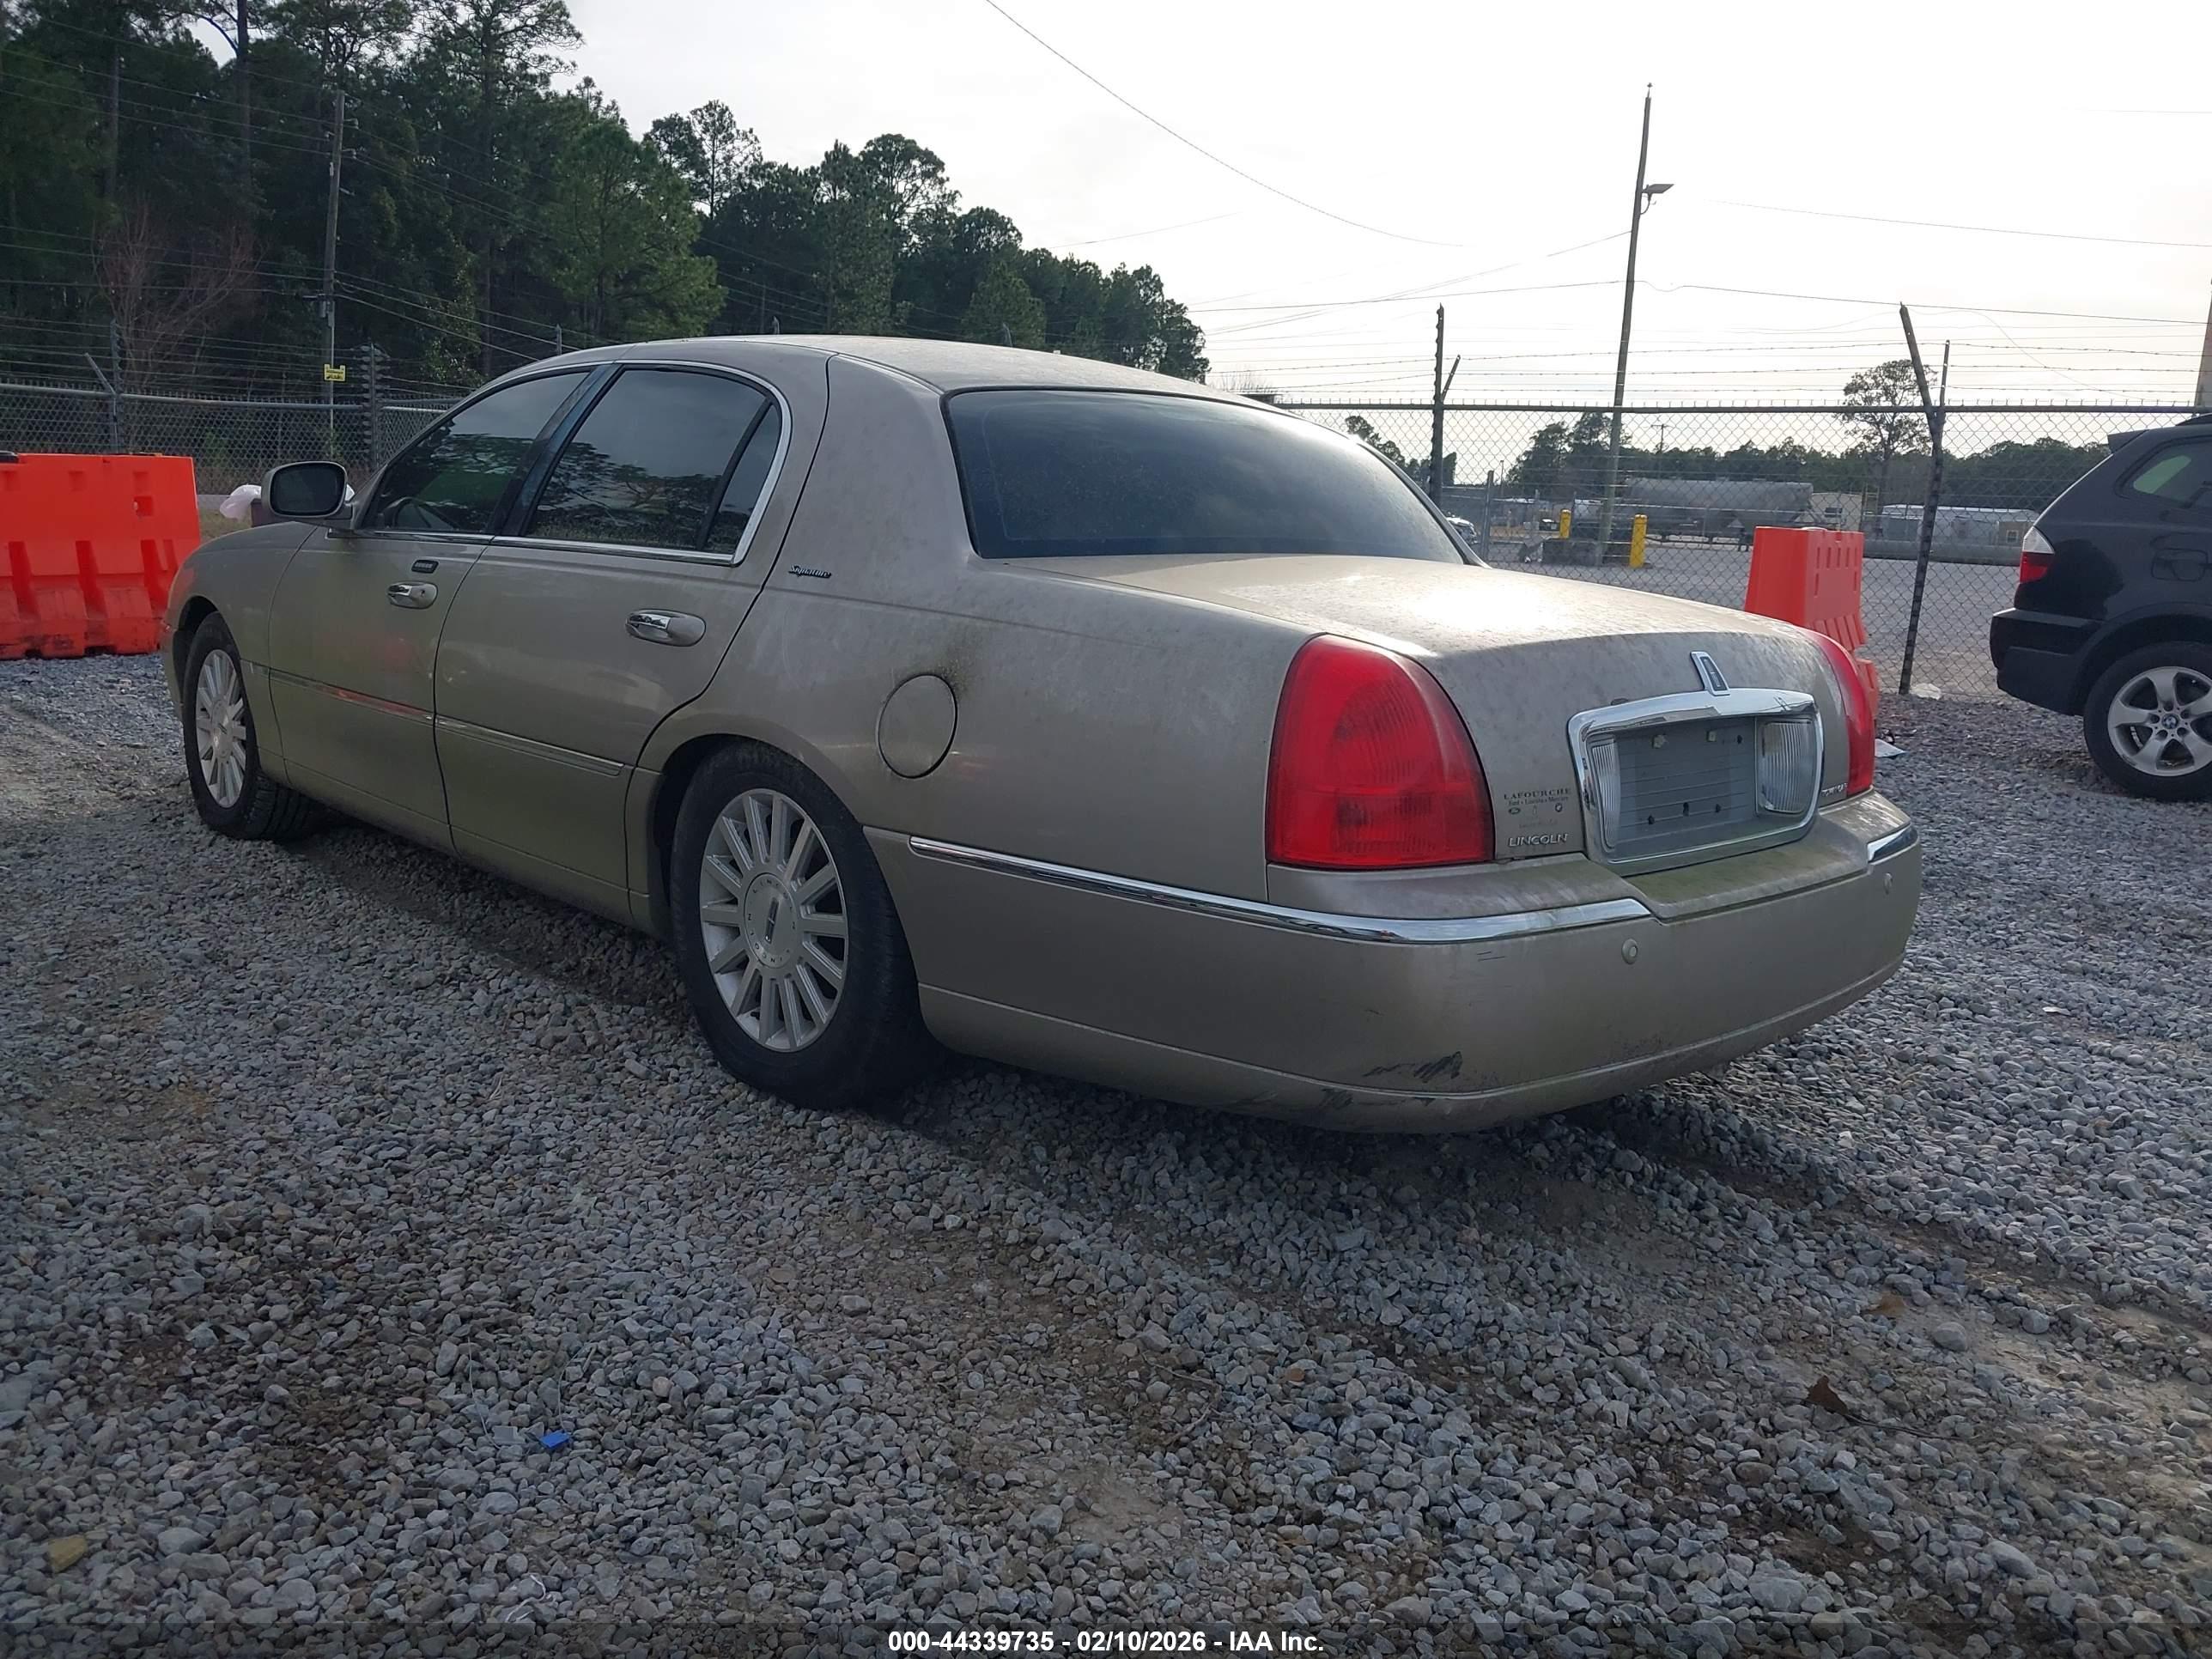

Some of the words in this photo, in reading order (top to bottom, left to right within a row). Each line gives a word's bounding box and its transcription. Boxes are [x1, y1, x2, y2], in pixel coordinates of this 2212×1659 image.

[788, 565, 832, 579] Signature
[1504, 788, 1571, 799] LAFOURCHE
[1508, 833, 1569, 848] LINCOLN
